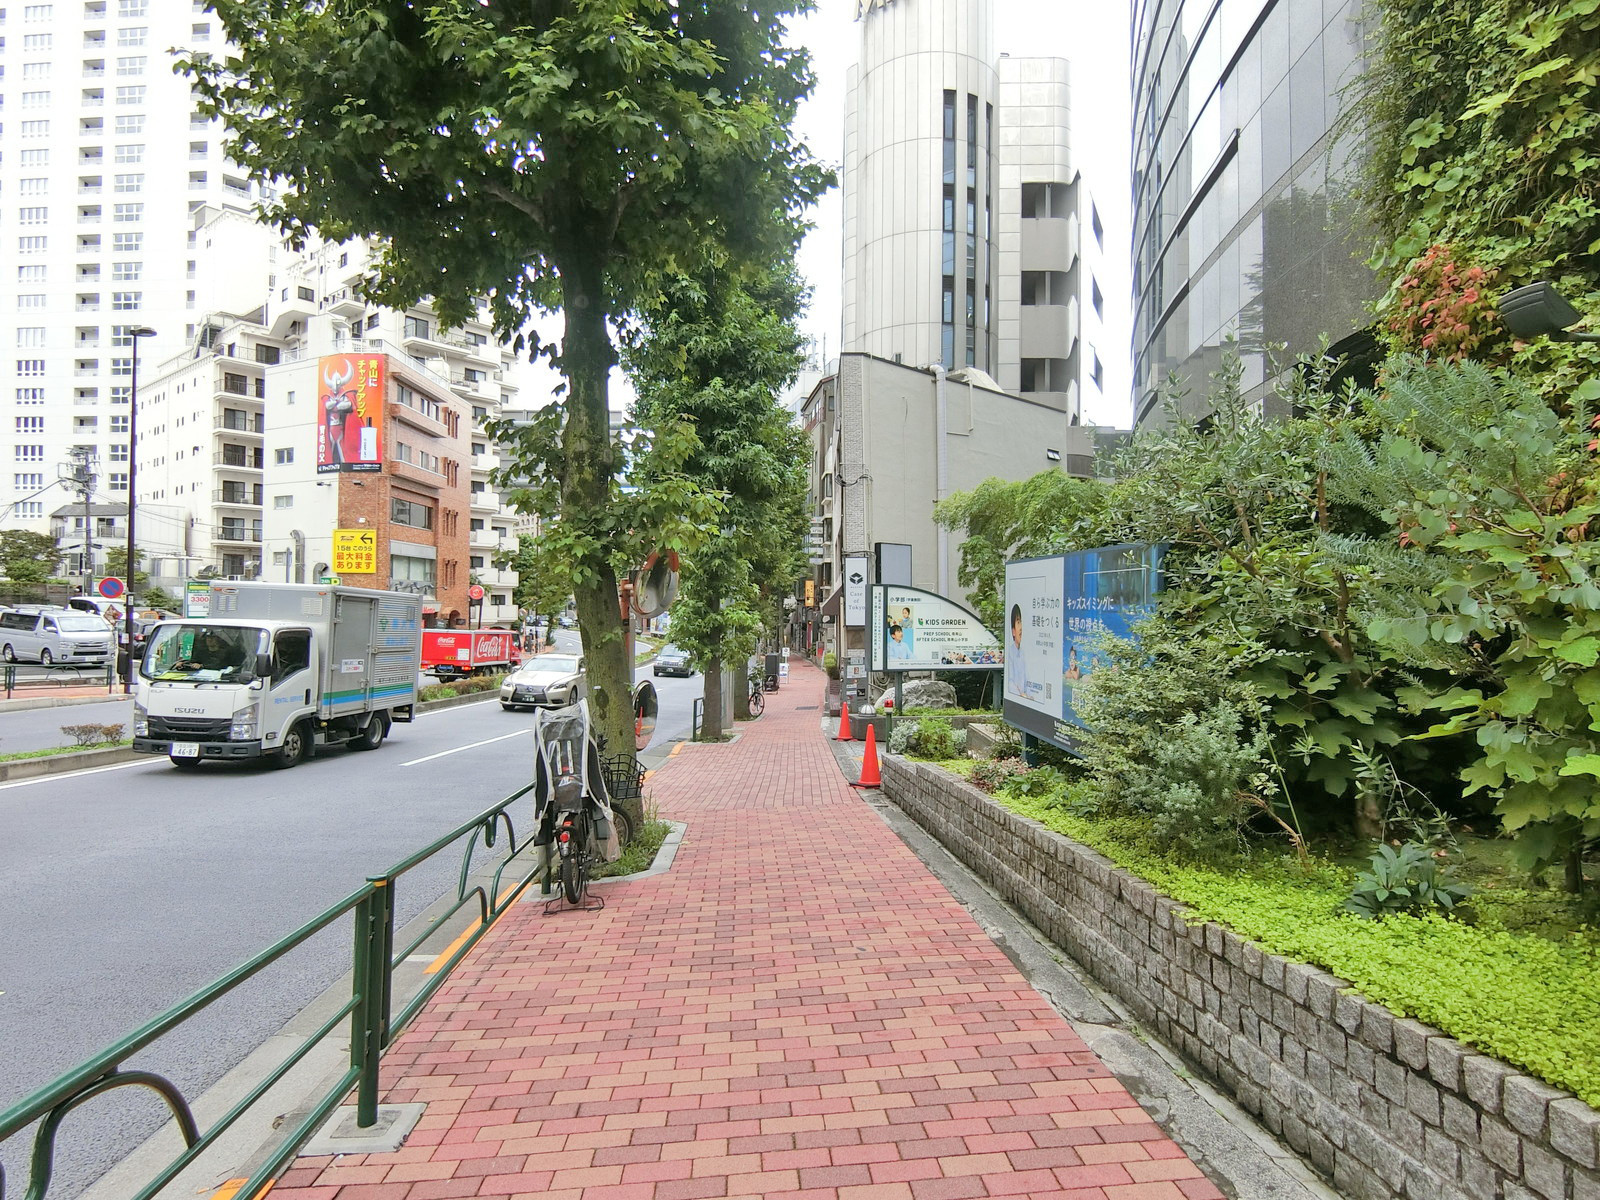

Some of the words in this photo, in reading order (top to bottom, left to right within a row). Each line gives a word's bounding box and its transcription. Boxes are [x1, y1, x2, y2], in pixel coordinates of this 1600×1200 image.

[368, 360, 378, 387] 青山に
[357, 360, 366, 418] チャップアップ
[336, 552, 373, 561] 最大料金
[336, 561, 373, 570] あります
[1032, 597, 1060, 610] 自ら学ぶ力の
[1067, 596, 1114, 611] キッズスイミングに
[1032, 615, 1060, 629] 基礎をつくる
